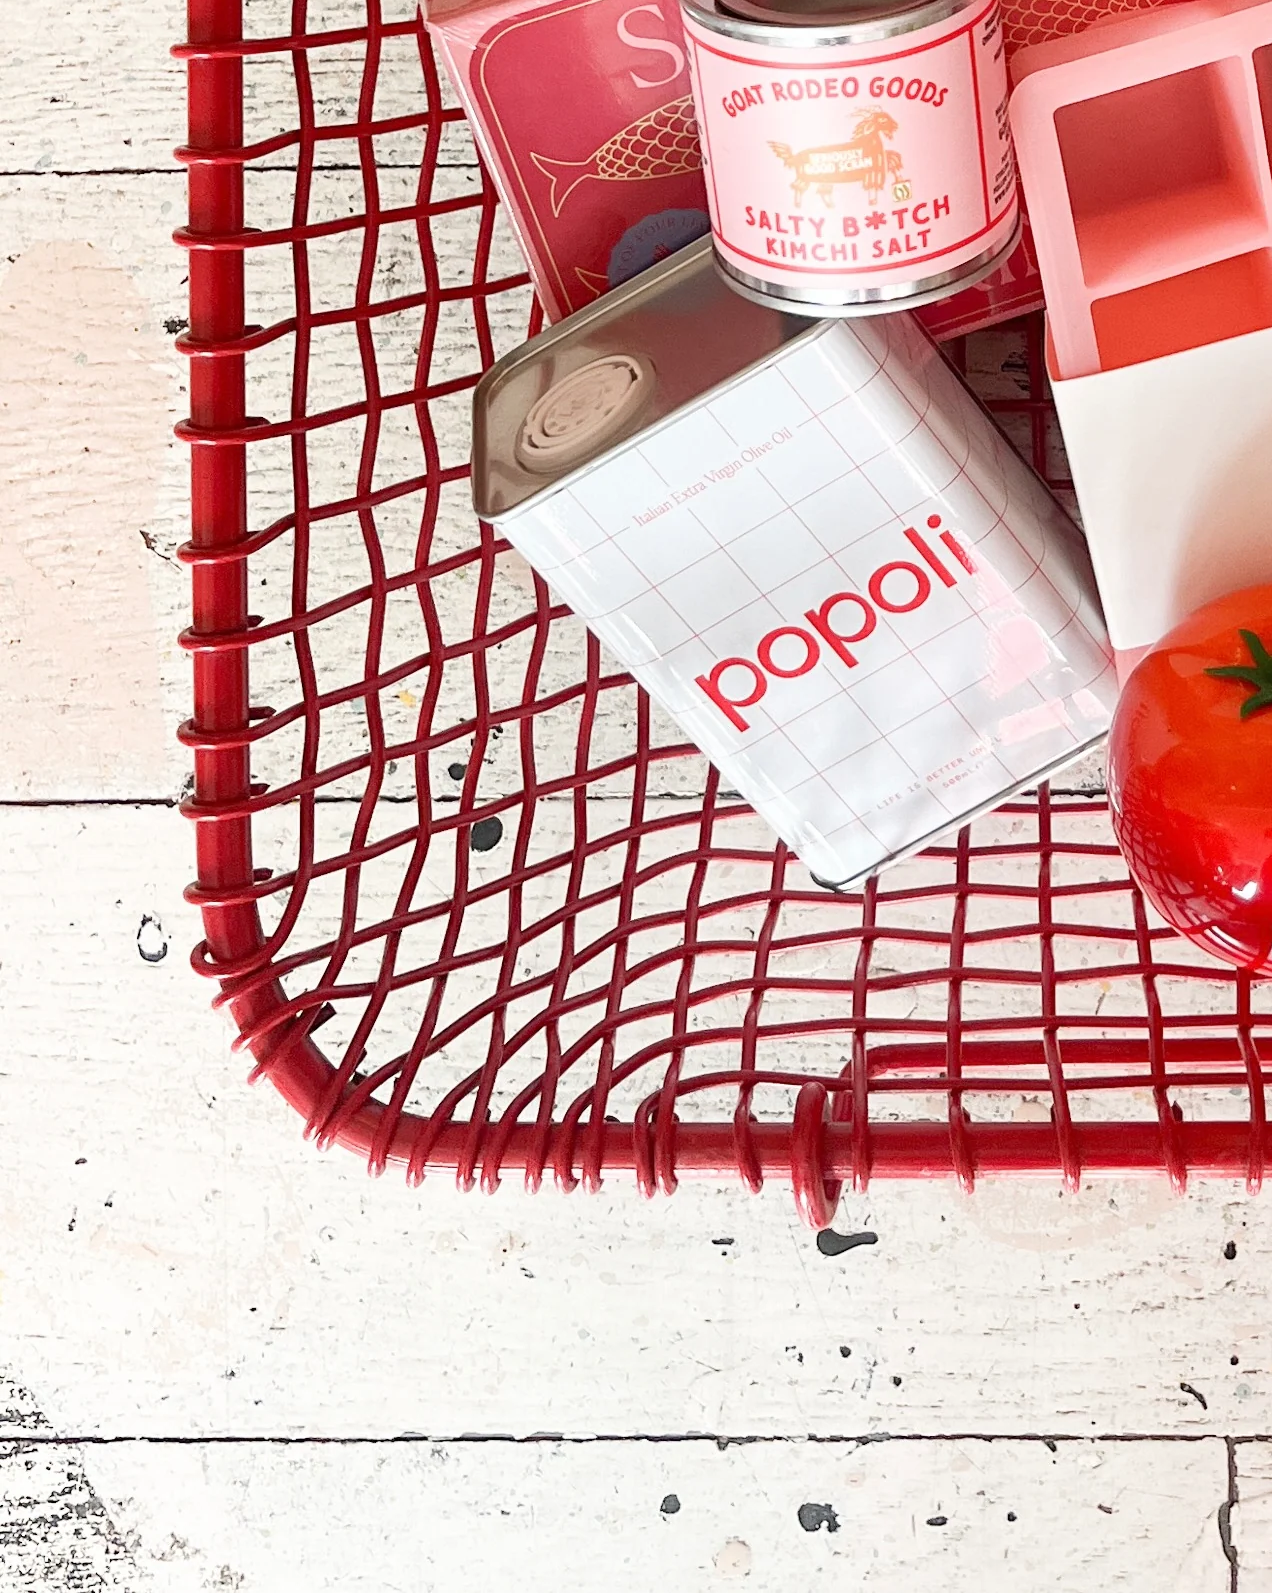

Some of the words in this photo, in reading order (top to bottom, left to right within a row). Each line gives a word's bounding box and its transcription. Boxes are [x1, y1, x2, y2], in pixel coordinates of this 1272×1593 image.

[722, 84, 766, 118] GOAT
[774, 77, 859, 102] RODEO
[869, 76, 949, 108] GOODS
[744, 205, 826, 238] SALTY
[765, 237, 858, 262] KIMCHI
[871, 229, 932, 258] SALT
[632, 500, 674, 527] Italian
[670, 481, 708, 505] Extra
[703, 459, 743, 484] Virgin
[740, 441, 773, 463] Olive
[771, 427, 793, 445] Oil
[695, 513, 977, 734] popoli
